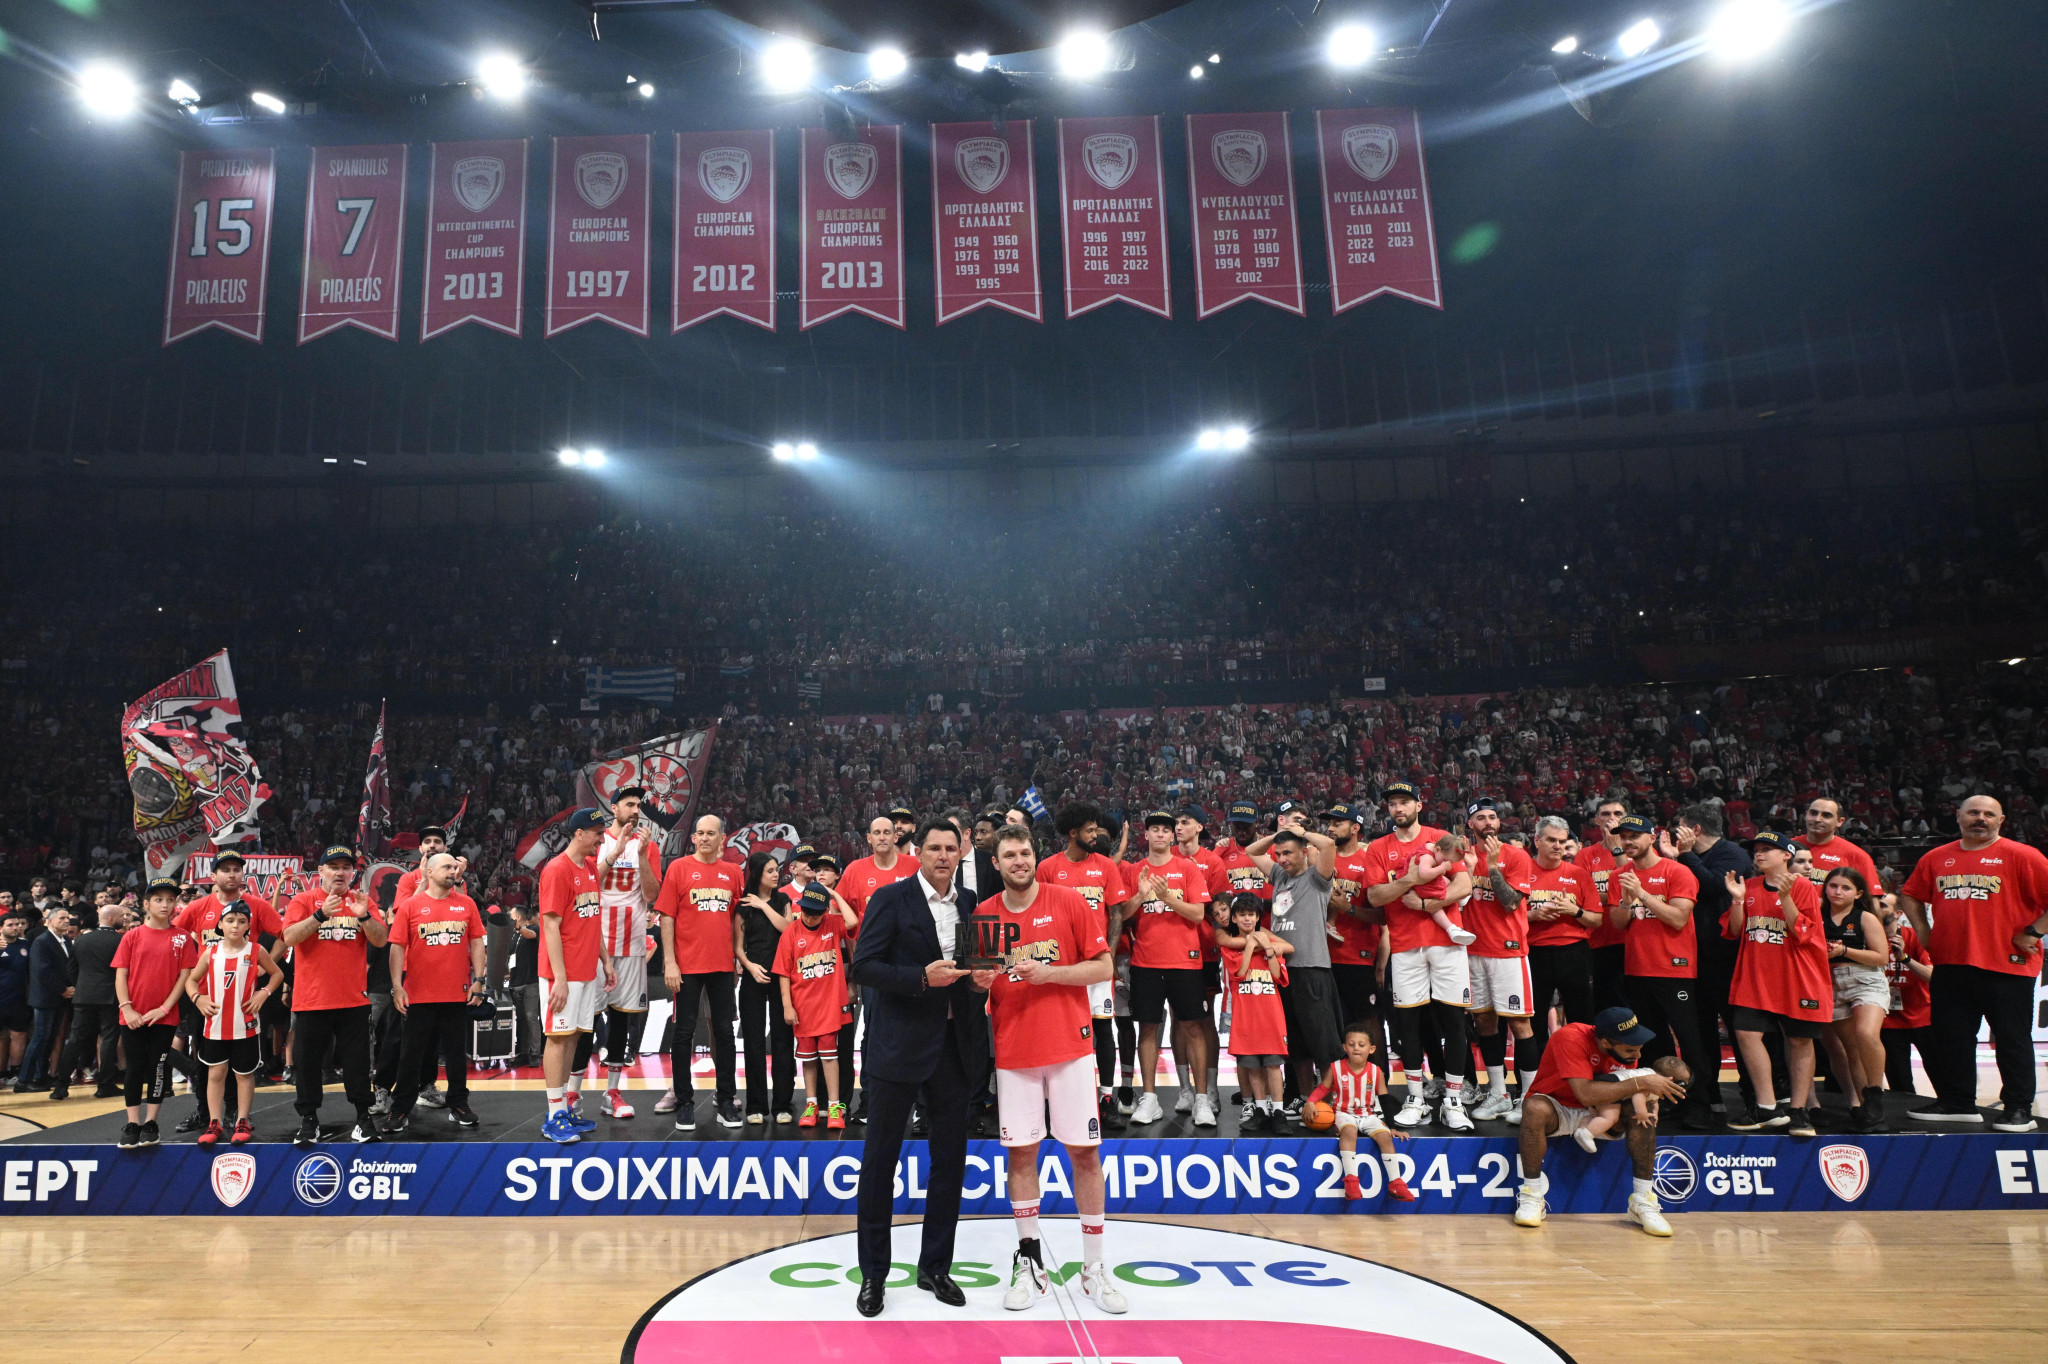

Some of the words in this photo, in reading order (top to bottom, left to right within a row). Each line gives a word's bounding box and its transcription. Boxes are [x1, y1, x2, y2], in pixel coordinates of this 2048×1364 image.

[962, 141, 1002, 150] OLYMPIACOS
[1089, 137, 1130, 146] OLYMPIACOS
[201, 159, 253, 177] PRINTEZIS
[329, 158, 389, 177] SPANOULIS
[1202, 195, 1285, 208] ΚΥΠΕΛΛΟΥΧΟΣ
[1334, 188, 1418, 203] ΚΥΠΕΛΛΟΥΧΟΣ
[945, 202, 1024, 215] ΠΡΩΤΑΘΛΗΤΗΣ
[1073, 198, 1153, 211] ΠΡΩΤΑΘΛΗΤΗΣ
[1350, 202, 1404, 216] ΕΛΛΑΔΑΣ
[696, 212, 752, 224] EUROPEAN
[816, 208, 886, 221] BACK2BACK
[1087, 212, 1140, 224] ΕΛΛΑΔΑΣ
[1218, 208, 1271, 221] ΕΛΛΑΔΑΣ
[189, 198, 254, 257] 15
[337, 197, 376, 256] 7
[437, 219, 515, 232] INTERCONTINENTAL
[572, 218, 628, 230] EUROPEAN
[824, 222, 880, 234] EUROPEAN
[959, 215, 1012, 228] ΕΛΛΑΔΑΣ
[694, 224, 755, 237] CHAMPIONS
[1213, 230, 1239, 241] 1976
[1253, 229, 1277, 239] 1977
[1346, 224, 1372, 235] 2010
[1387, 222, 1412, 233] 2011
[468, 234, 484, 244] CUP
[569, 231, 630, 243] CHAMPIONS
[821, 235, 882, 247] CHAMPIONS
[954, 236, 979, 248] 1949
[993, 235, 1018, 246] 1960
[1082, 232, 1108, 243] 1996
[1122, 231, 1146, 242] 1997
[1348, 238, 1374, 250] 2022
[1388, 236, 1414, 247] 2023
[445, 246, 505, 260] CHAMPIONS
[954, 250, 980, 261] 1976
[994, 249, 1019, 260] 1978
[1083, 246, 1108, 257] 2012
[1122, 245, 1147, 256] 2015
[1214, 244, 1240, 255] 1978
[1254, 243, 1280, 254] 1980
[1215, 258, 1241, 269] 1994
[1255, 257, 1280, 268] 1997
[1348, 252, 1375, 264] 2024
[956, 264, 980, 276] 1993
[994, 263, 1020, 274] 1994
[1084, 260, 1109, 271] 2016
[1123, 259, 1149, 270] 2022
[692, 264, 755, 292] 2012
[821, 261, 883, 289] 2013
[1104, 274, 1130, 285] 2023
[1236, 272, 1262, 283] 2002
[443, 272, 503, 301] 2013
[566, 270, 630, 297] 1997
[976, 278, 1000, 289] 1995
[185, 278, 247, 305] PIRAEUS
[320, 277, 382, 304] PIRAEUS
[1232, 806, 1254, 814] CHAMPIONS
[1820, 854, 1840, 862] bwin
[1233, 880, 1243, 890] 20
[1253, 880, 1264, 889] 25
[1936, 875, 2002, 894] CHAMPIONS
[689, 888, 731, 904] CHAMPIONS
[1483, 890, 1495, 901] 25
[1945, 889, 1957, 900] 20
[1970, 889, 1988, 900] 25
[698, 901, 709, 911] 20
[718, 901, 728, 911] 25
[1143, 902, 1154, 914] 20
[578, 908, 588, 918] 20
[318, 930, 331, 940] 20
[344, 930, 356, 940] 25
[418, 921, 467, 938] CHAMPIONS
[426, 935, 438, 945] 20
[449, 934, 461, 944] 25
[955, 922, 1021, 957] MVP
[1769, 933, 1784, 945] 25
[802, 967, 814, 979] 20
[824, 963, 835, 975] 25
[224, 971, 236, 990] 7
[1238, 983, 1250, 994] 20
[1262, 984, 1276, 994] 25
[1703, 1151, 1777, 1168] Stoiximan
[1824, 1149, 1860, 1157] OLYMPIACOS
[218, 1157, 251, 1165] OLYMPIACOS
[349, 1159, 417, 1174] Stoiximan
[504, 1156, 809, 1201] STOIXIMAN
[1704, 1170, 1775, 1196] GBL
[348, 1176, 409, 1201] GBL
[1014, 1207, 1038, 1216] GSA
